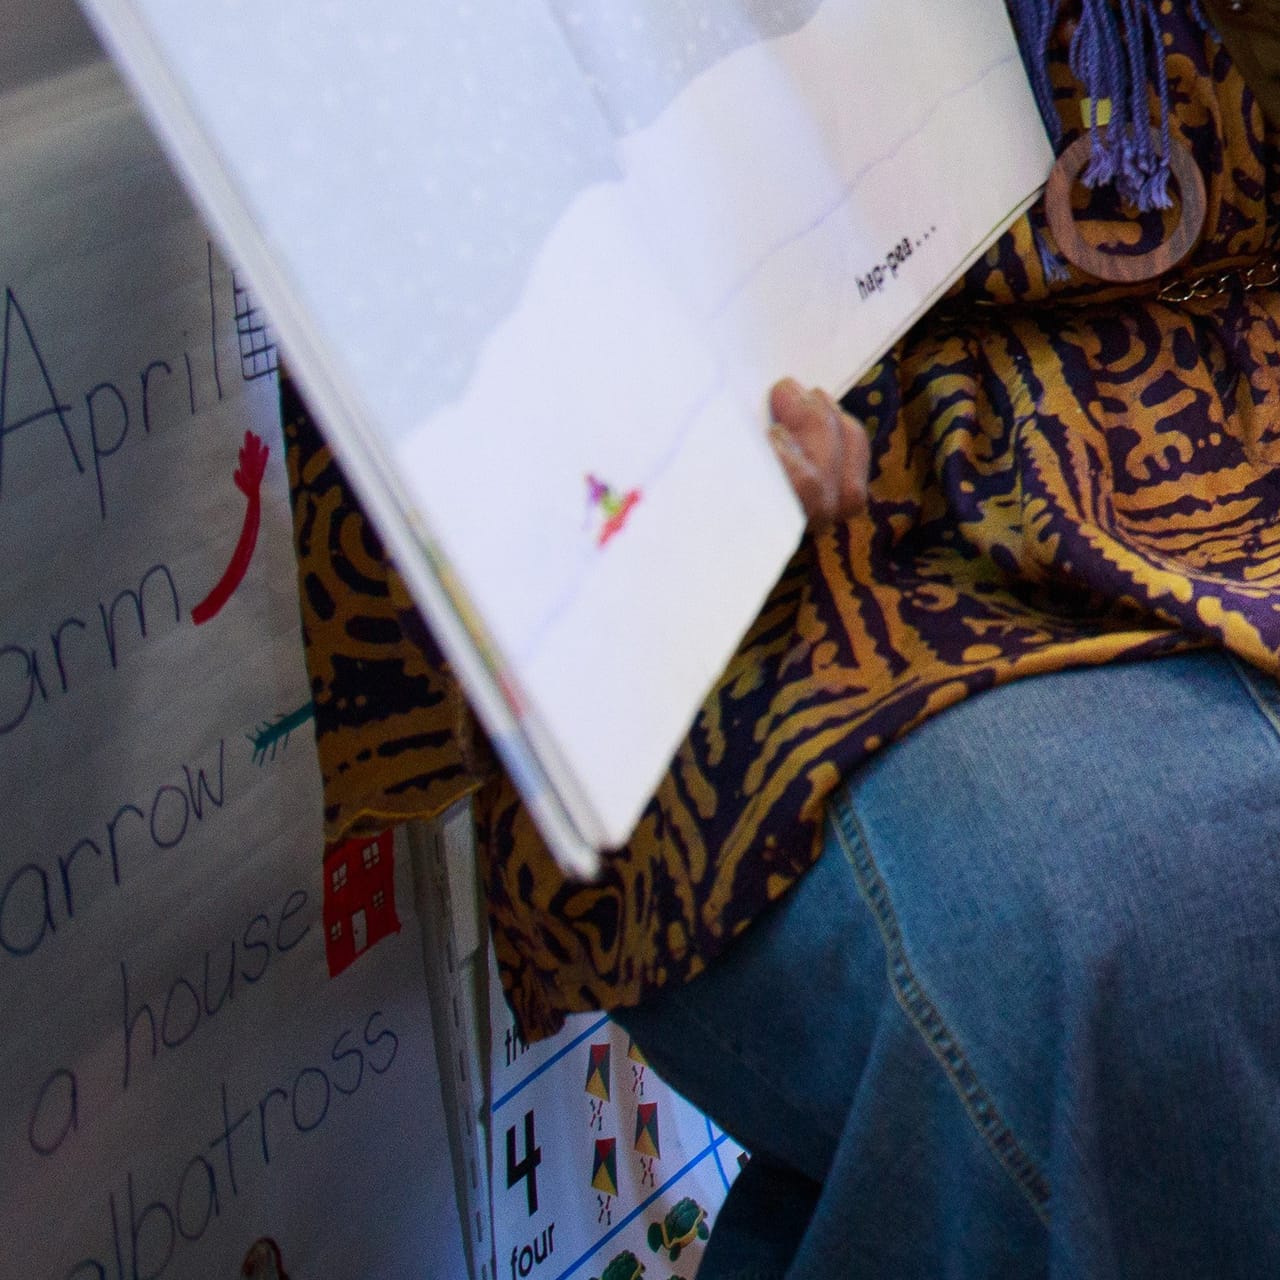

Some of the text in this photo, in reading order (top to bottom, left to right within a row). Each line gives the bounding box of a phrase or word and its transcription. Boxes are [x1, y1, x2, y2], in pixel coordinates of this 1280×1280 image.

[0, 241, 224, 519] April
[0, 739, 225, 958] arrow
[28, 890, 312, 1156] a house
[66, 1010, 400, 1280] lbatross
[506, 1108, 542, 1219] 4
[510, 1221, 557, 1280] four
